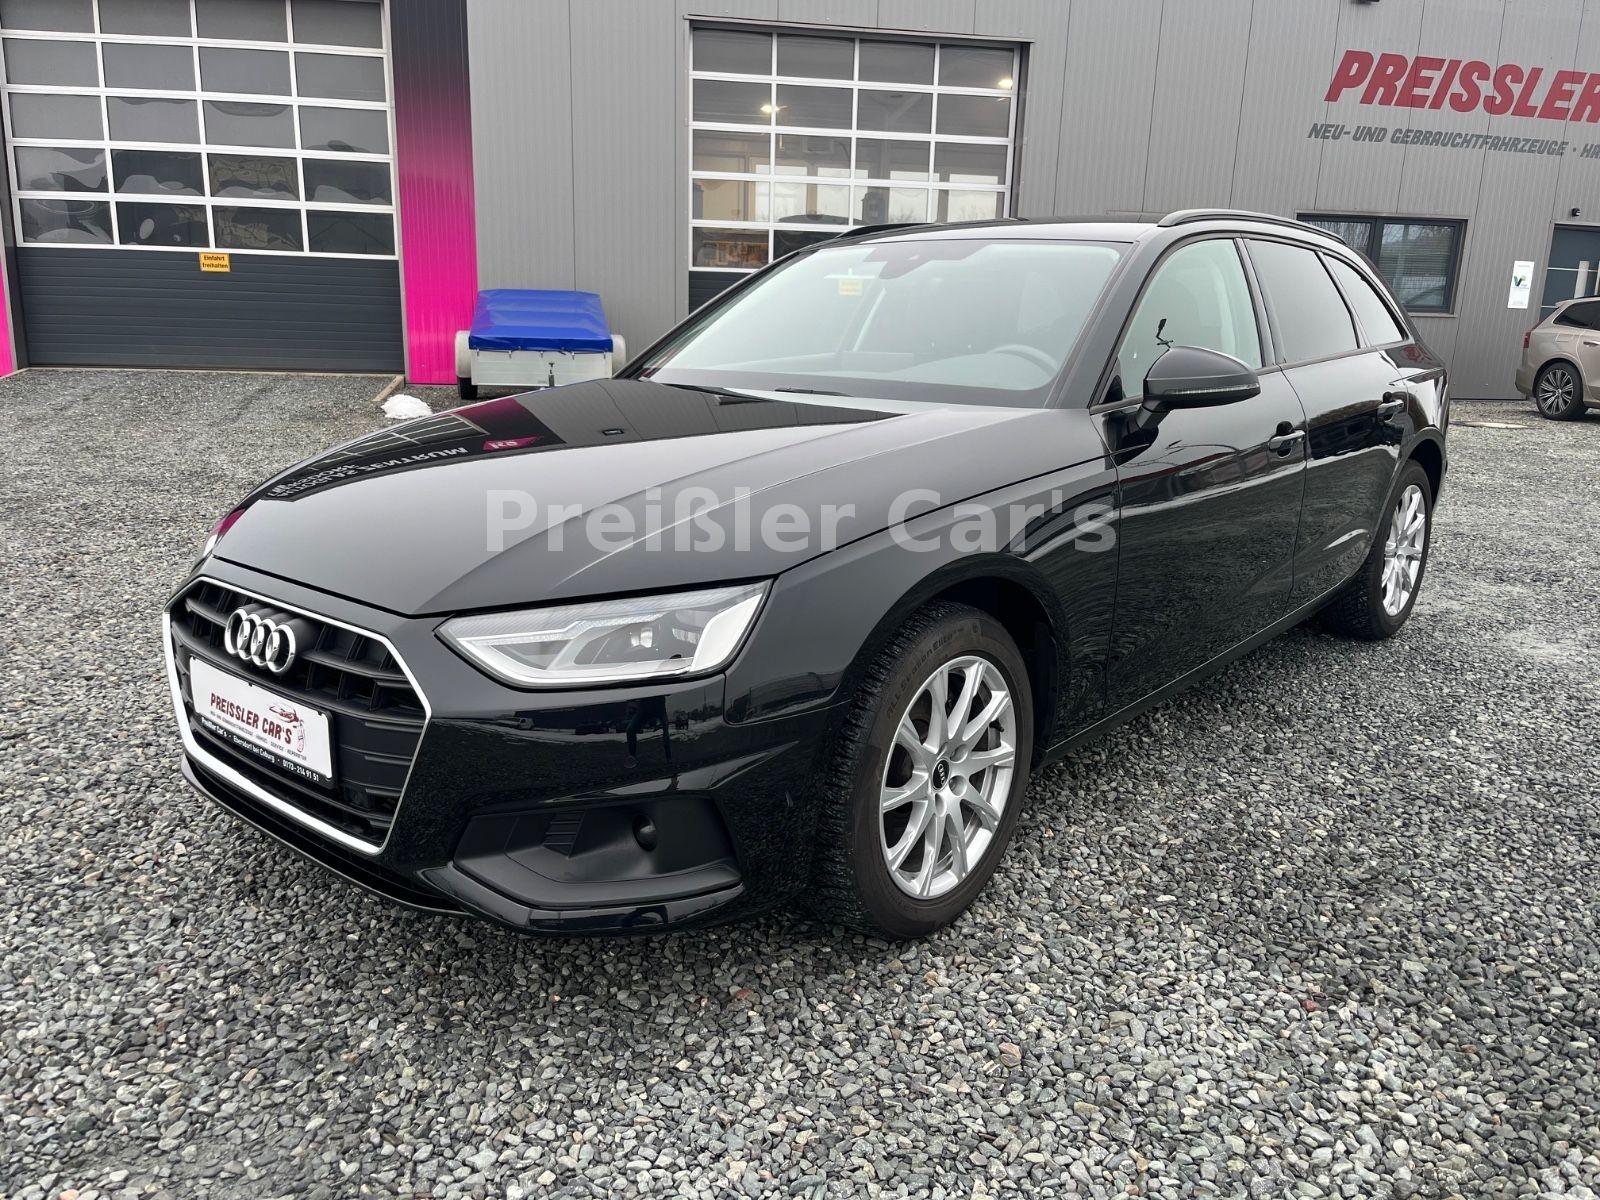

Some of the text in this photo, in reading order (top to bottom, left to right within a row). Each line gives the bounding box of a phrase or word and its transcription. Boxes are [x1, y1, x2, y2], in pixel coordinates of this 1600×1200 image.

[1324, 50, 1600, 123] PREISSLER
[1308, 123, 1350, 140] NEU-
[1352, 125, 1388, 143] UND
[1390, 128, 1569, 155] GEBRAUCHTFAHRZEUGE
[210, 693, 259, 729] PREISSLER
[262, 718, 293, 744] CAR'S
